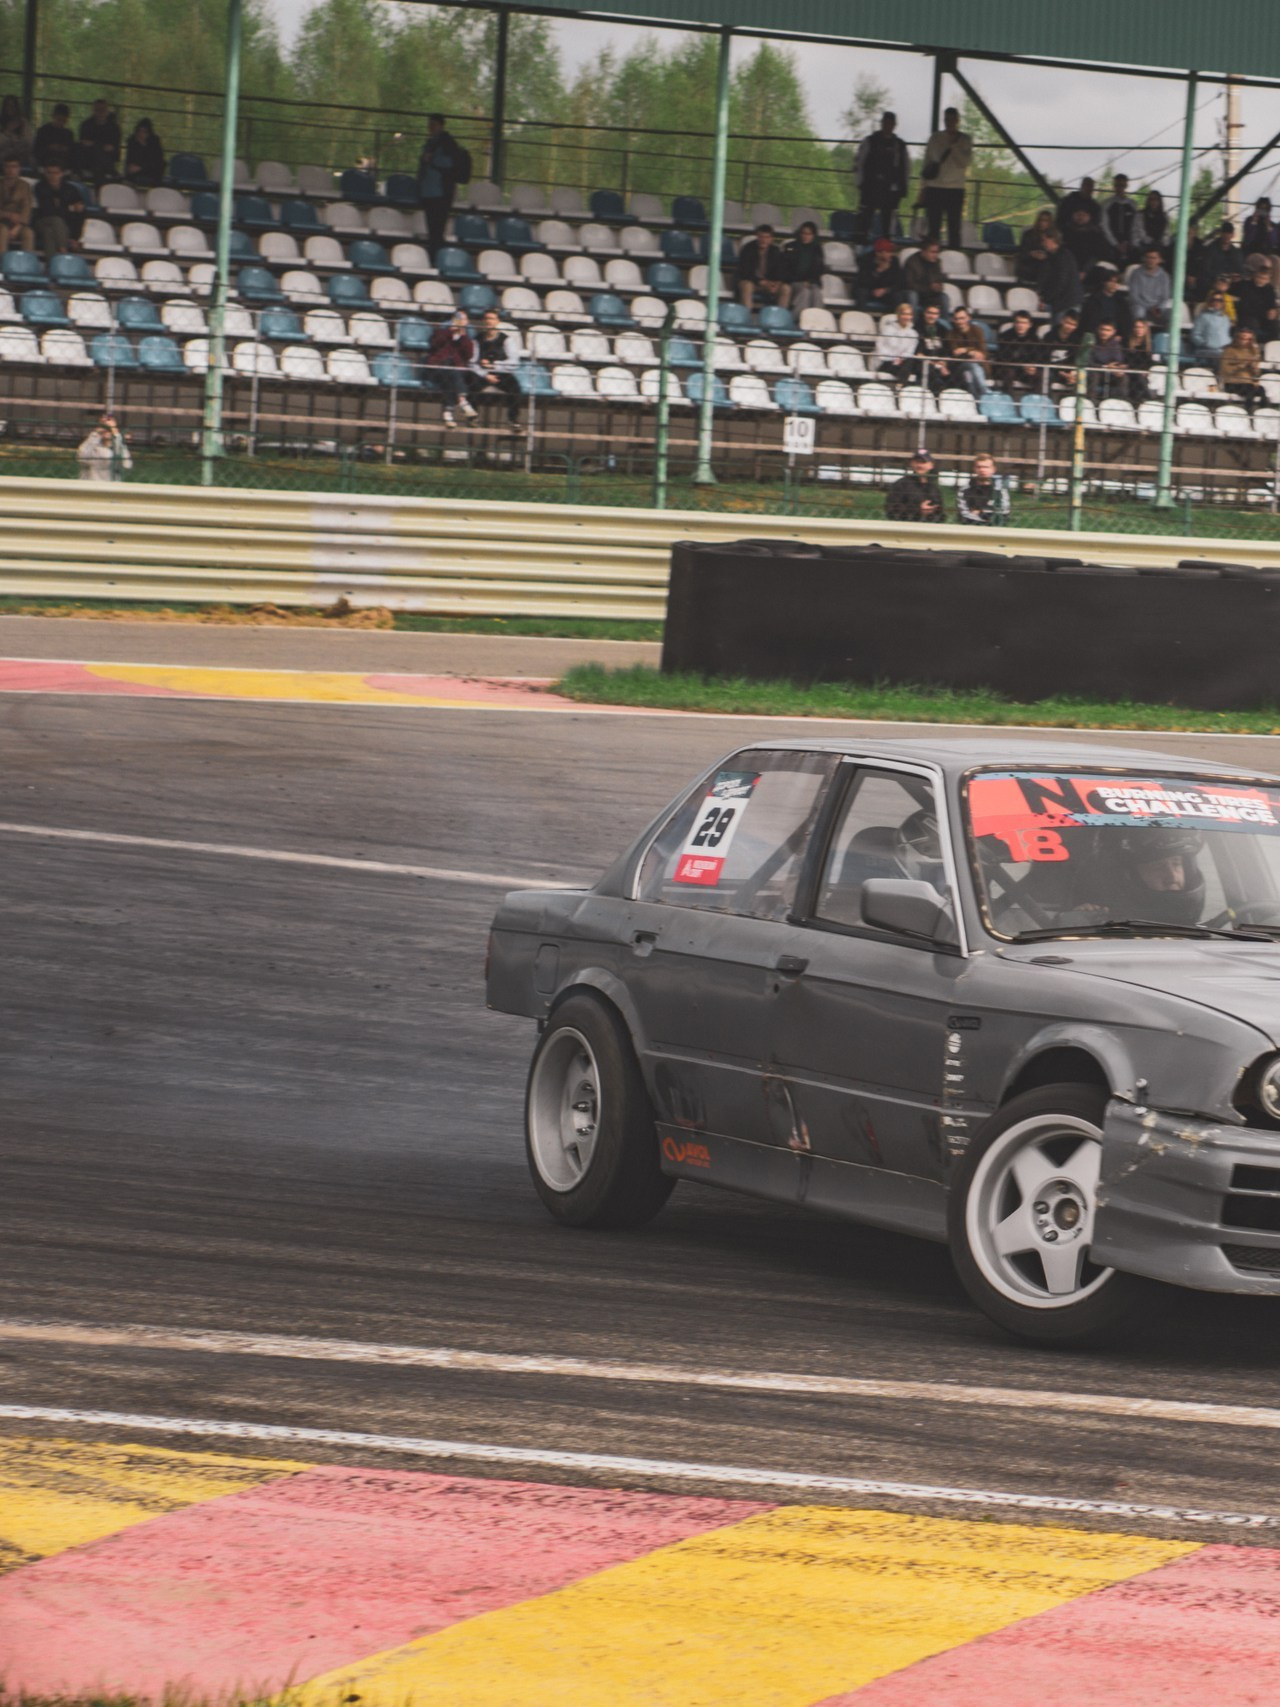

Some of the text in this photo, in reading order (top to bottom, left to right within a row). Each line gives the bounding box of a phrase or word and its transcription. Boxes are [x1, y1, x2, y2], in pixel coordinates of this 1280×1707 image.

[788, 420, 809, 437] 10
[1095, 786, 1202, 803] BURNING
[1203, 793, 1267, 810] TIRES
[1104, 798, 1279, 824] CHALLENGE
[691, 807, 736, 847] 29
[994, 829, 1070, 862] 18
